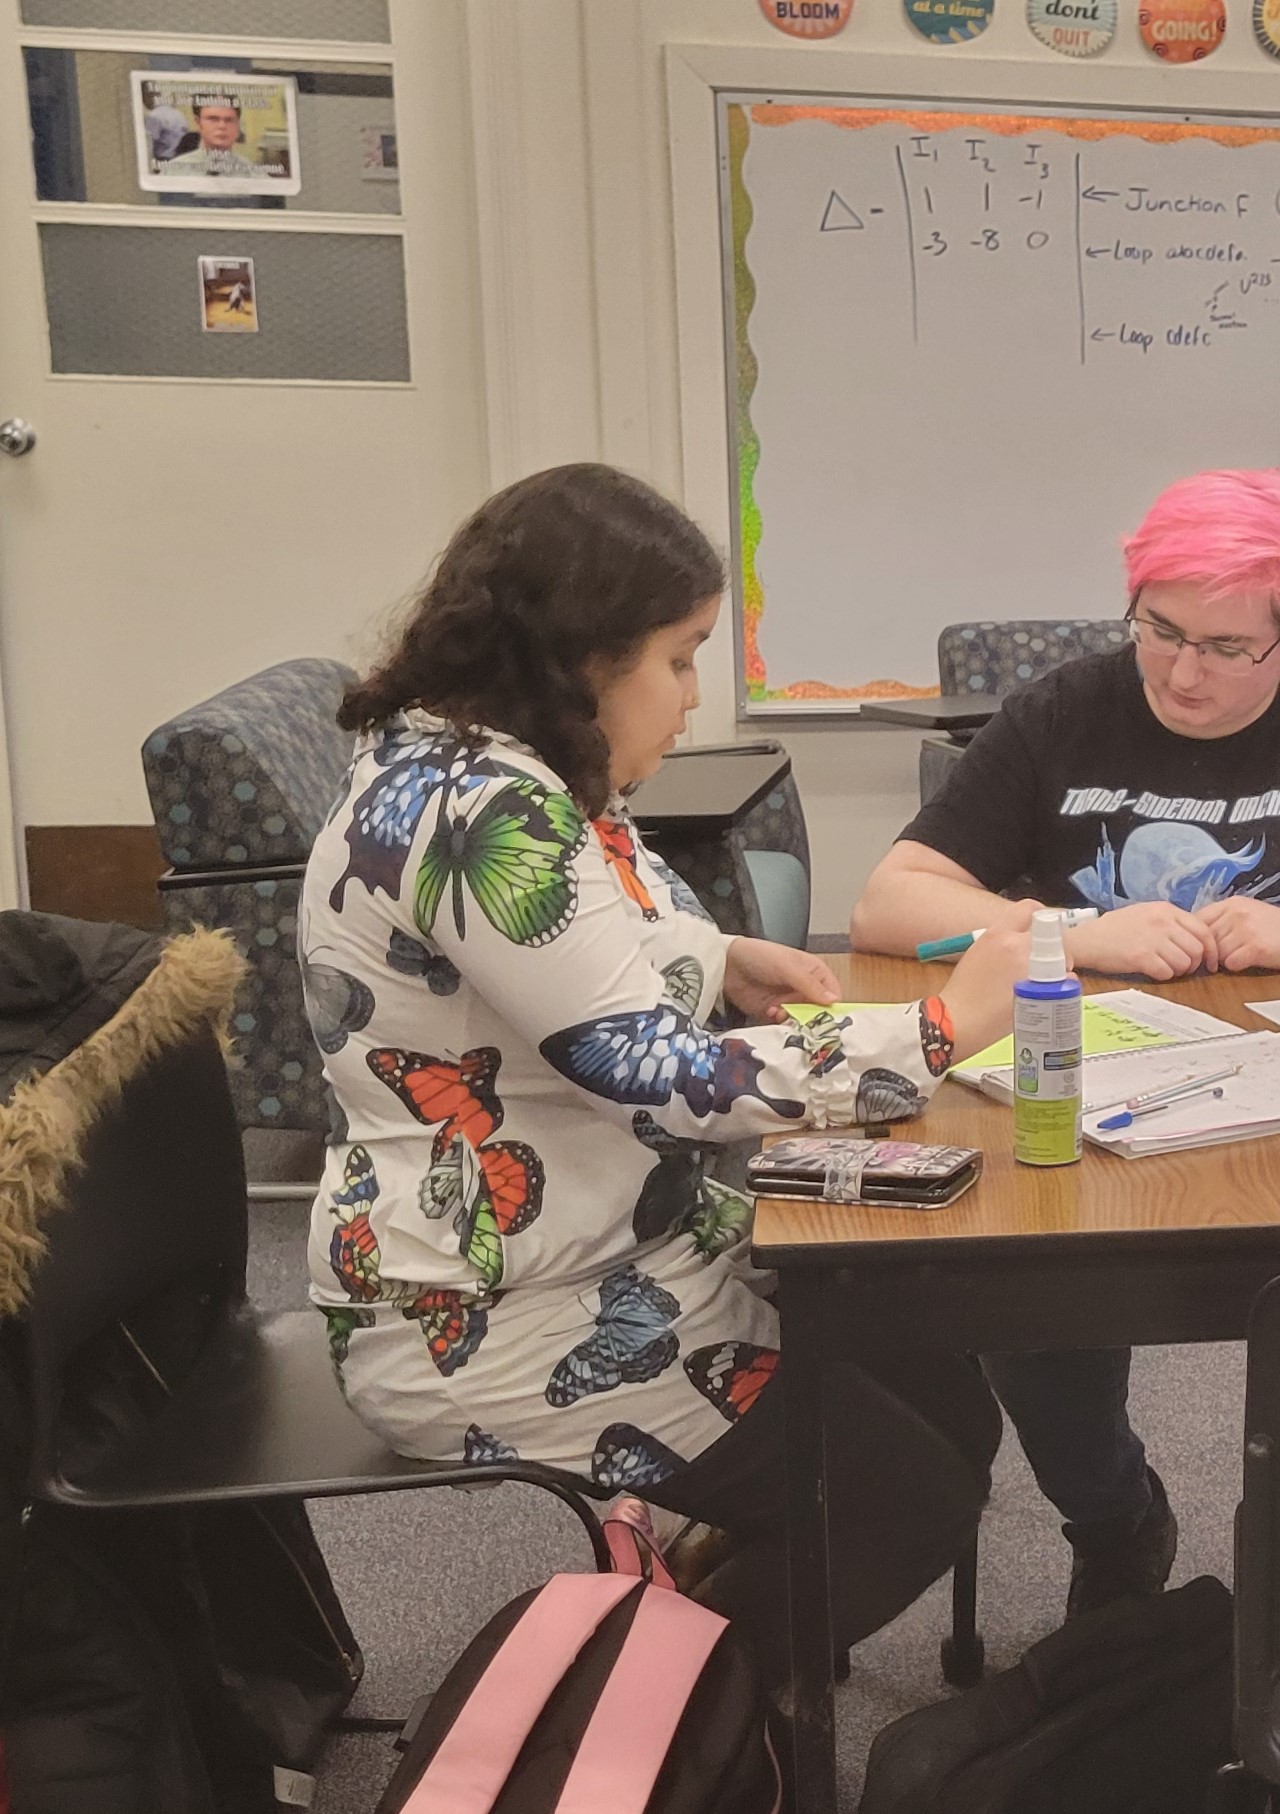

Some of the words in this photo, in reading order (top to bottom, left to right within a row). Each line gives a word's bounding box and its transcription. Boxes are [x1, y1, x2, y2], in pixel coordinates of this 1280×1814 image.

[776, 1, 839, 19] BLOOM
[933, 3, 945, 15] a
[949, 1, 985, 18] time
[1053, 28, 1091, 47] QUIT
[1151, 20, 1217, 41] GOING!
[1125, 187, 1227, 211] Junction
